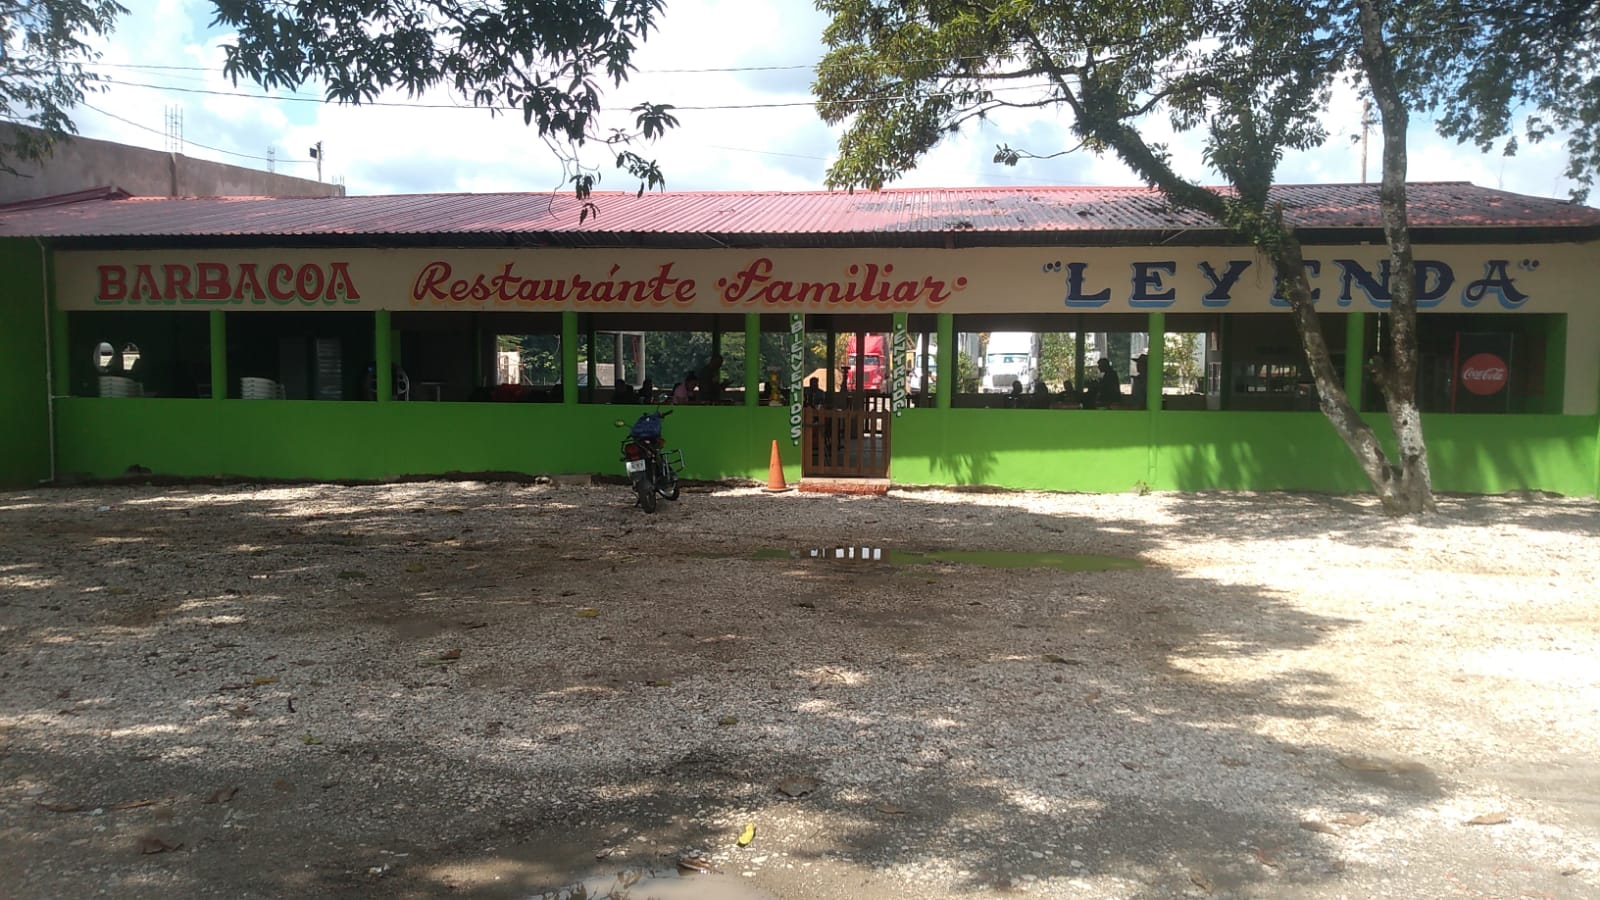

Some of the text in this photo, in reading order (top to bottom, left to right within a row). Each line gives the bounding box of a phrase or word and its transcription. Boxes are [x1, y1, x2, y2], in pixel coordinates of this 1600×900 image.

[97, 262, 361, 302] BARBACOA
[412, 257, 952, 304] Restauránte Familiar
[790, 320, 803, 439] BIENVENIDOS
